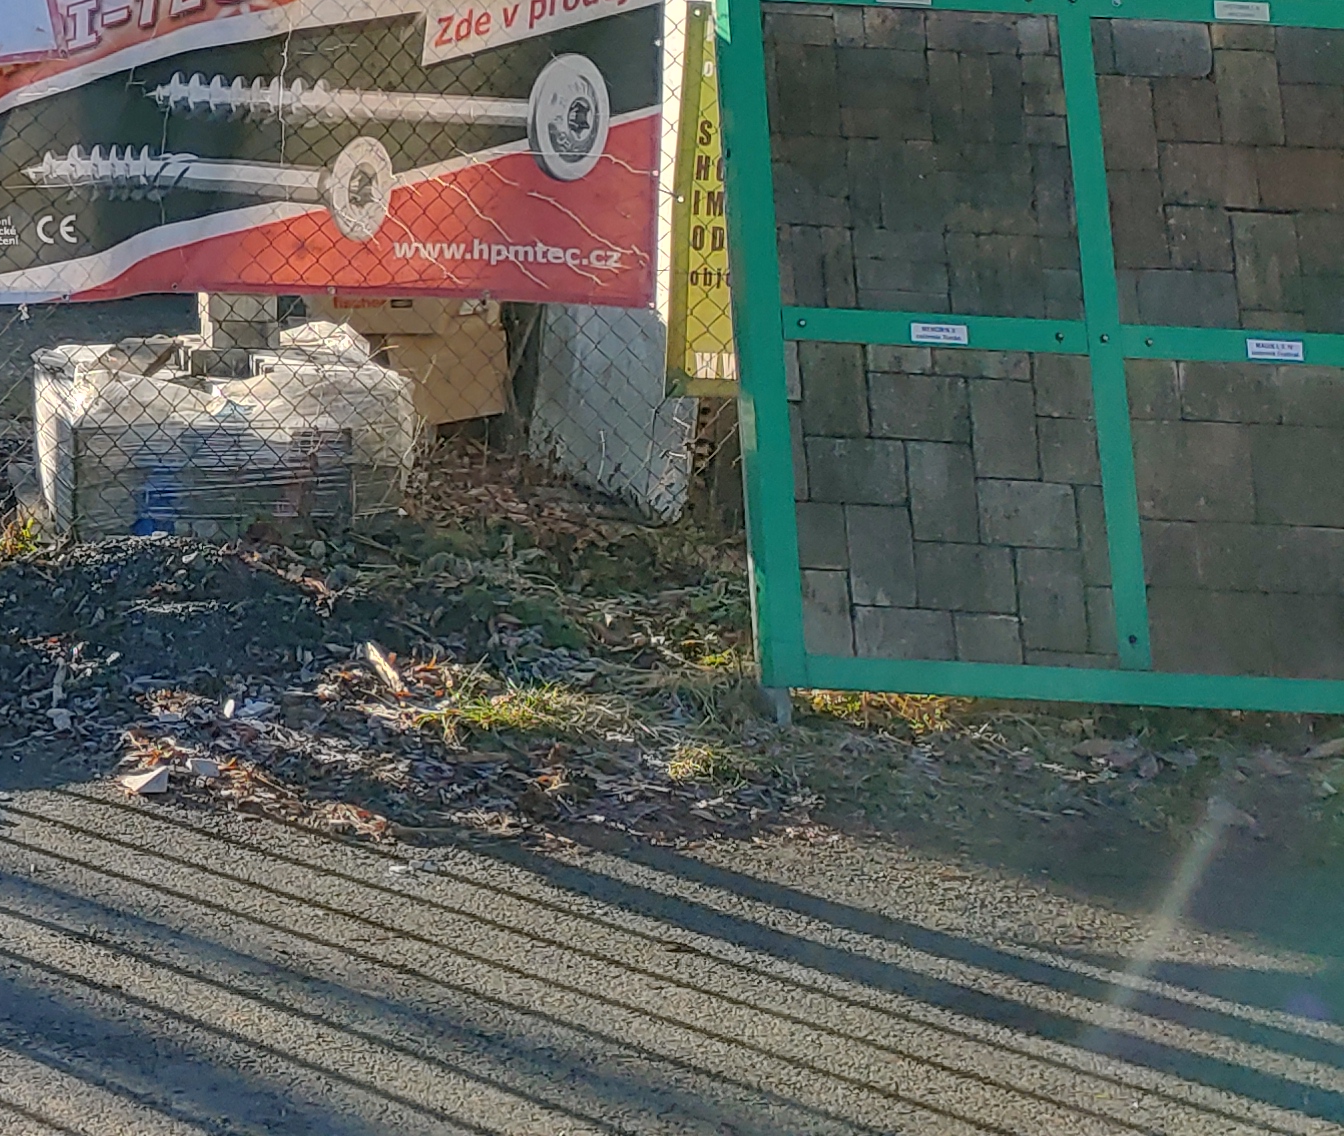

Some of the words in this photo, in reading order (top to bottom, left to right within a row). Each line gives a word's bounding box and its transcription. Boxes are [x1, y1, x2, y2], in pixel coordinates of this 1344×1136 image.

[434, 7, 492, 48] Zde
[502, 7, 519, 27] v
[36, 215, 78, 245] CE
[393, 238, 622, 266] www.hpmtec.cz
